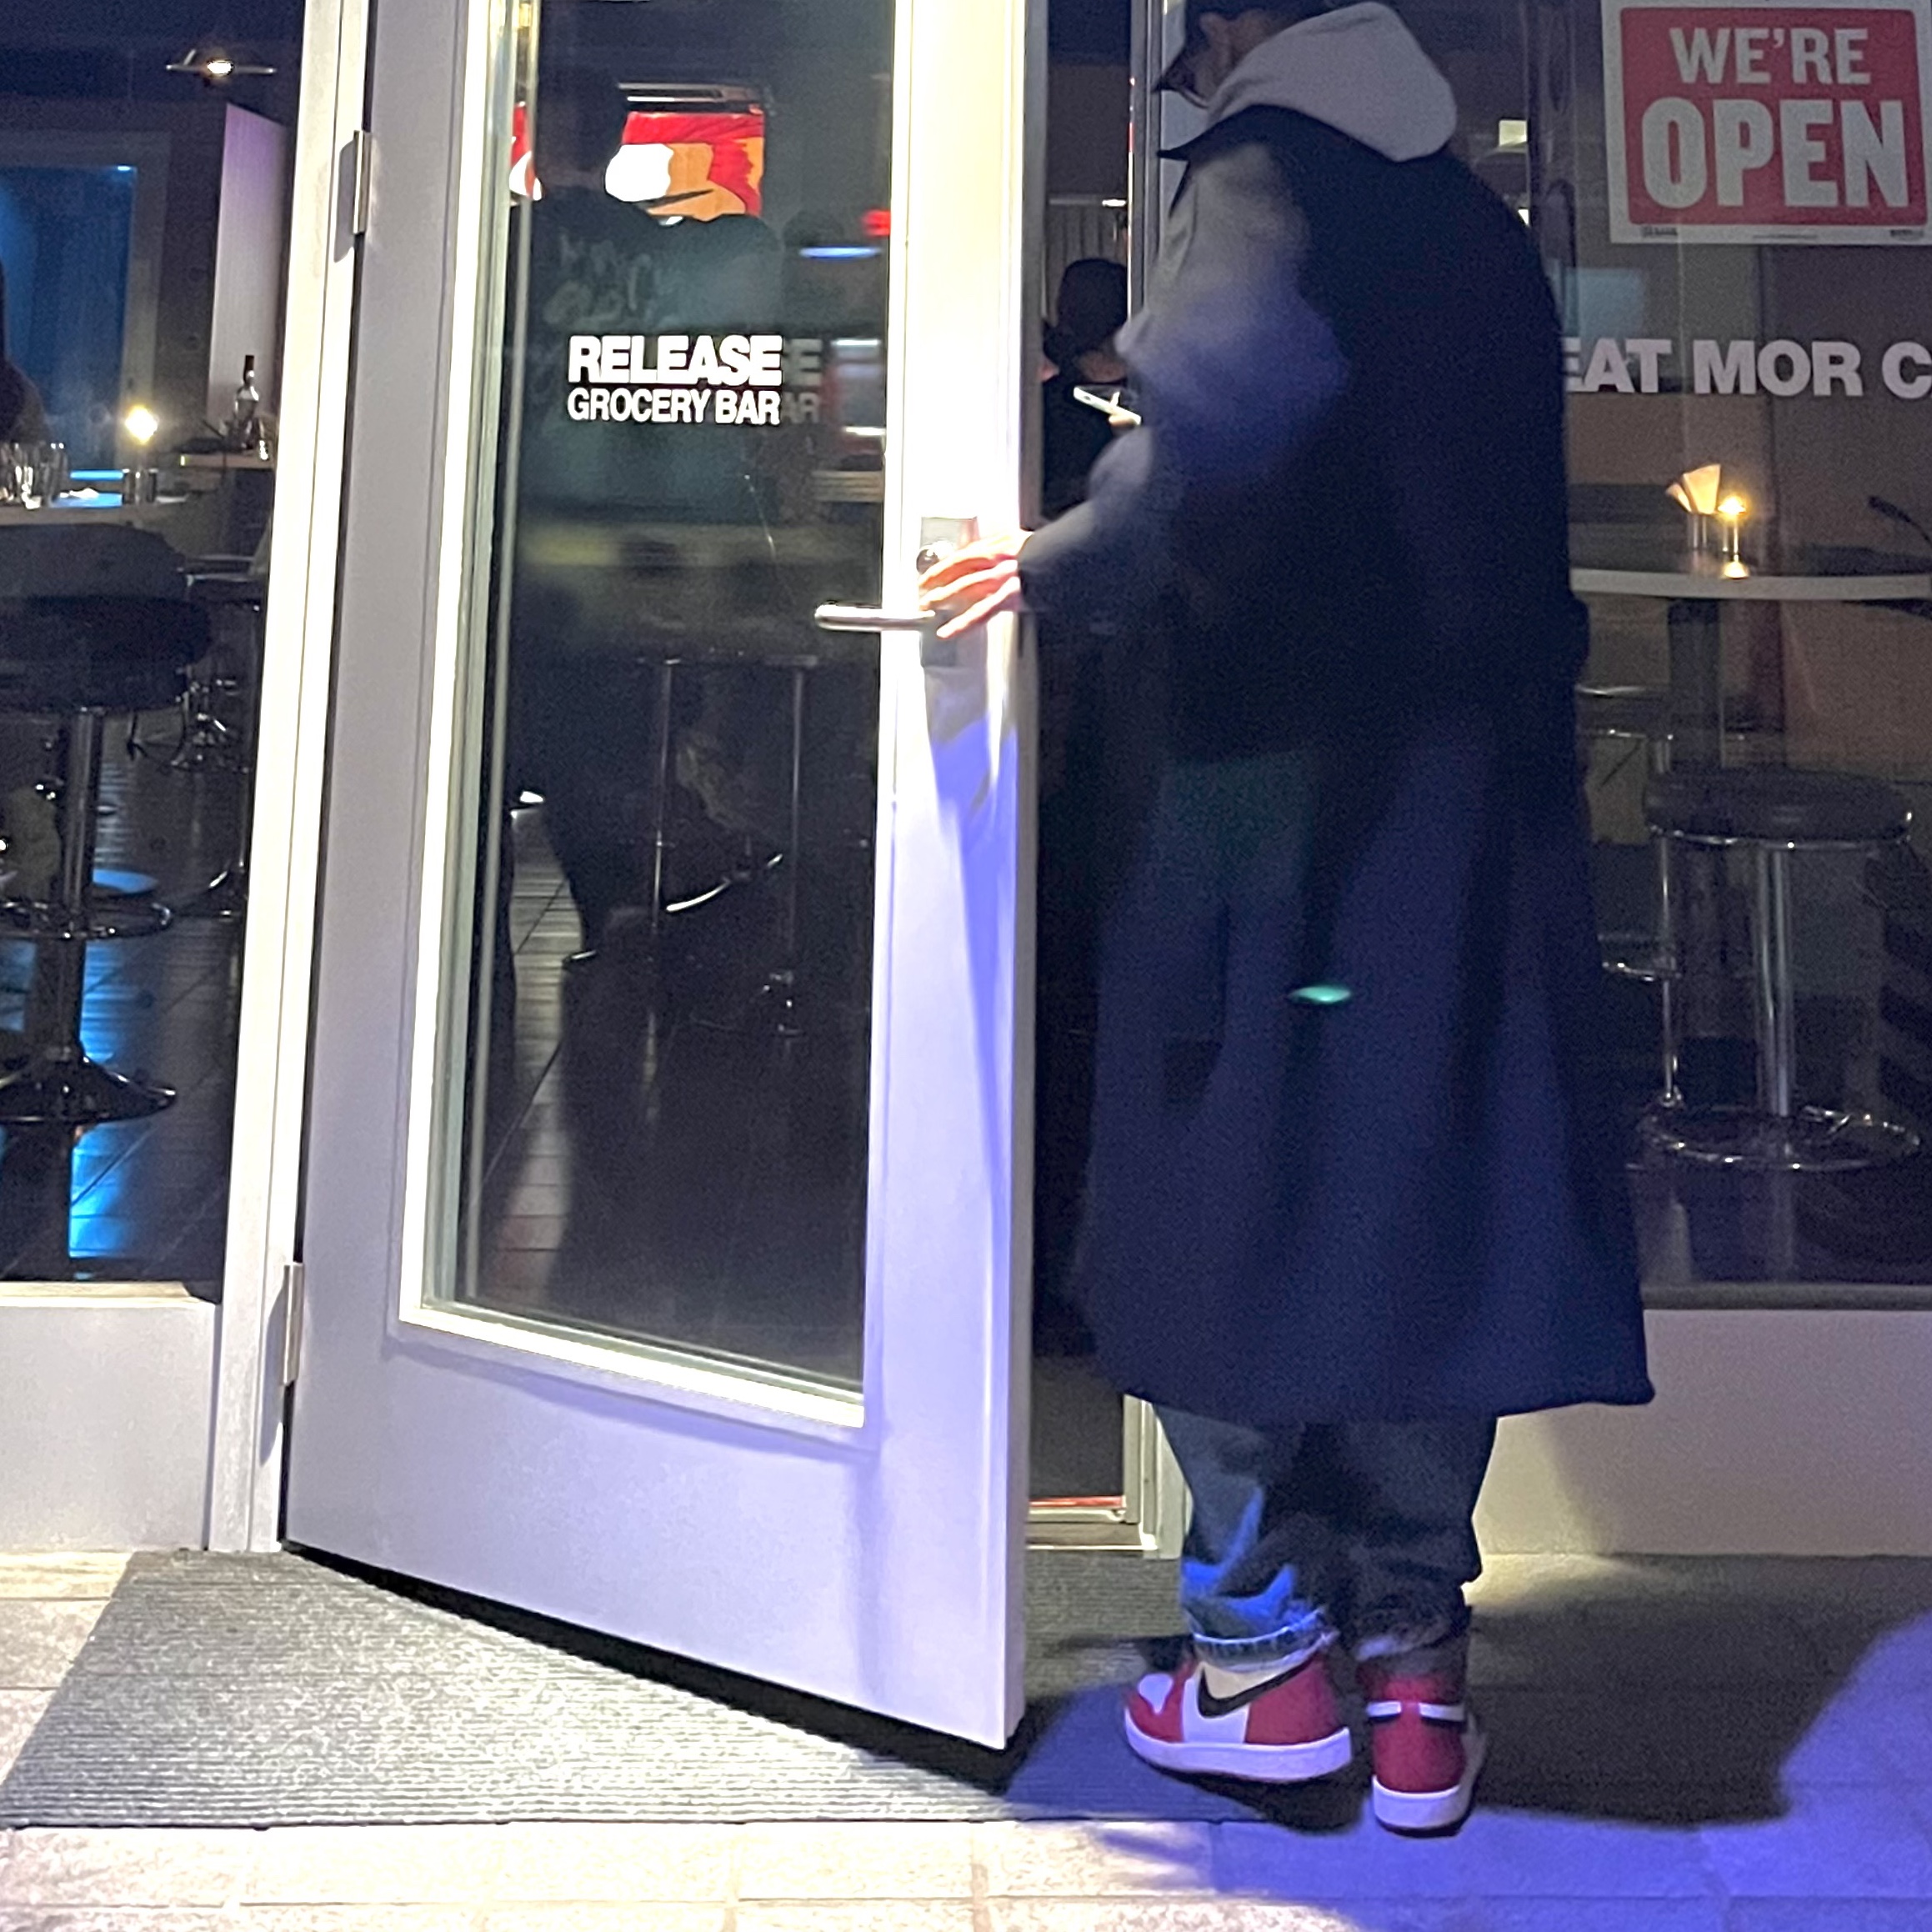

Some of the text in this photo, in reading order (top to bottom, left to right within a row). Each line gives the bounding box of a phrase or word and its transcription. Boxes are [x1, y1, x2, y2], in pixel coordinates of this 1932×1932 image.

[1669, 28, 1871, 84] WE'RE
[1641, 96, 1909, 208] OPEN
[568, 334, 783, 387] RELEASE
[1693, 340, 1864, 397] MOR
[568, 388, 711, 423] GROCERY
[714, 390, 781, 426] BAR
